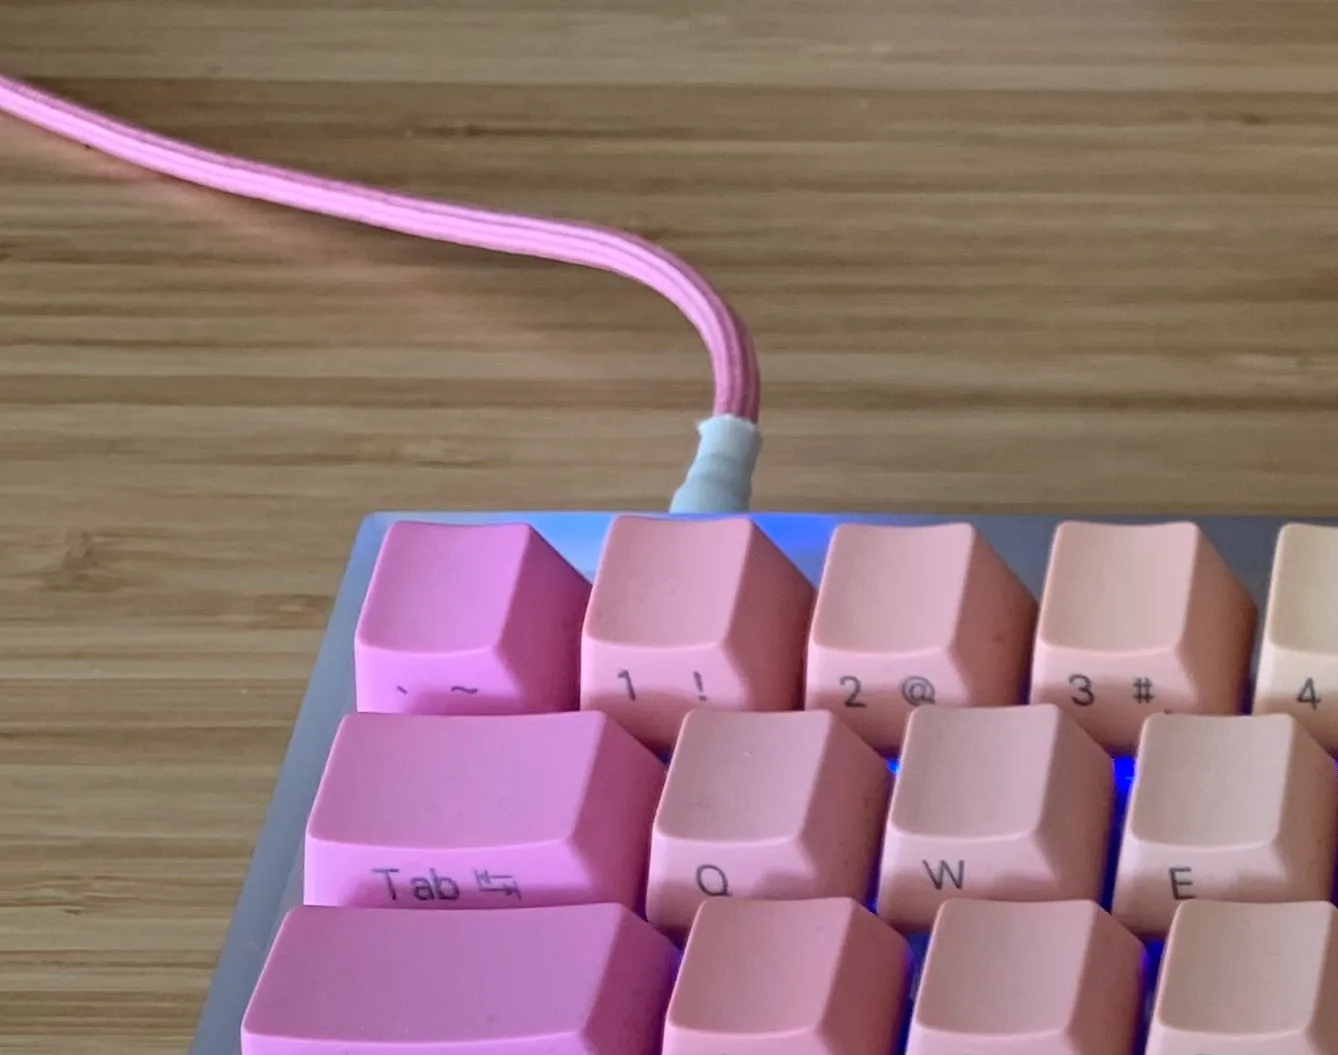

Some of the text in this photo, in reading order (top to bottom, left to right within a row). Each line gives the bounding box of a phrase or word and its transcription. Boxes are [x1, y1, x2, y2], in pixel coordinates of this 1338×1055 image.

[617, 669, 707, 702] 1 !
[839, 675, 937, 708] 2 @
[1068, 673, 1154, 707] 3 #
[1296, 677, 1322, 710] 4
[371, 867, 461, 902] Tab
[695, 863, 731, 898] Q
[921, 859, 966, 891] W
[1168, 866, 1198, 901] E
